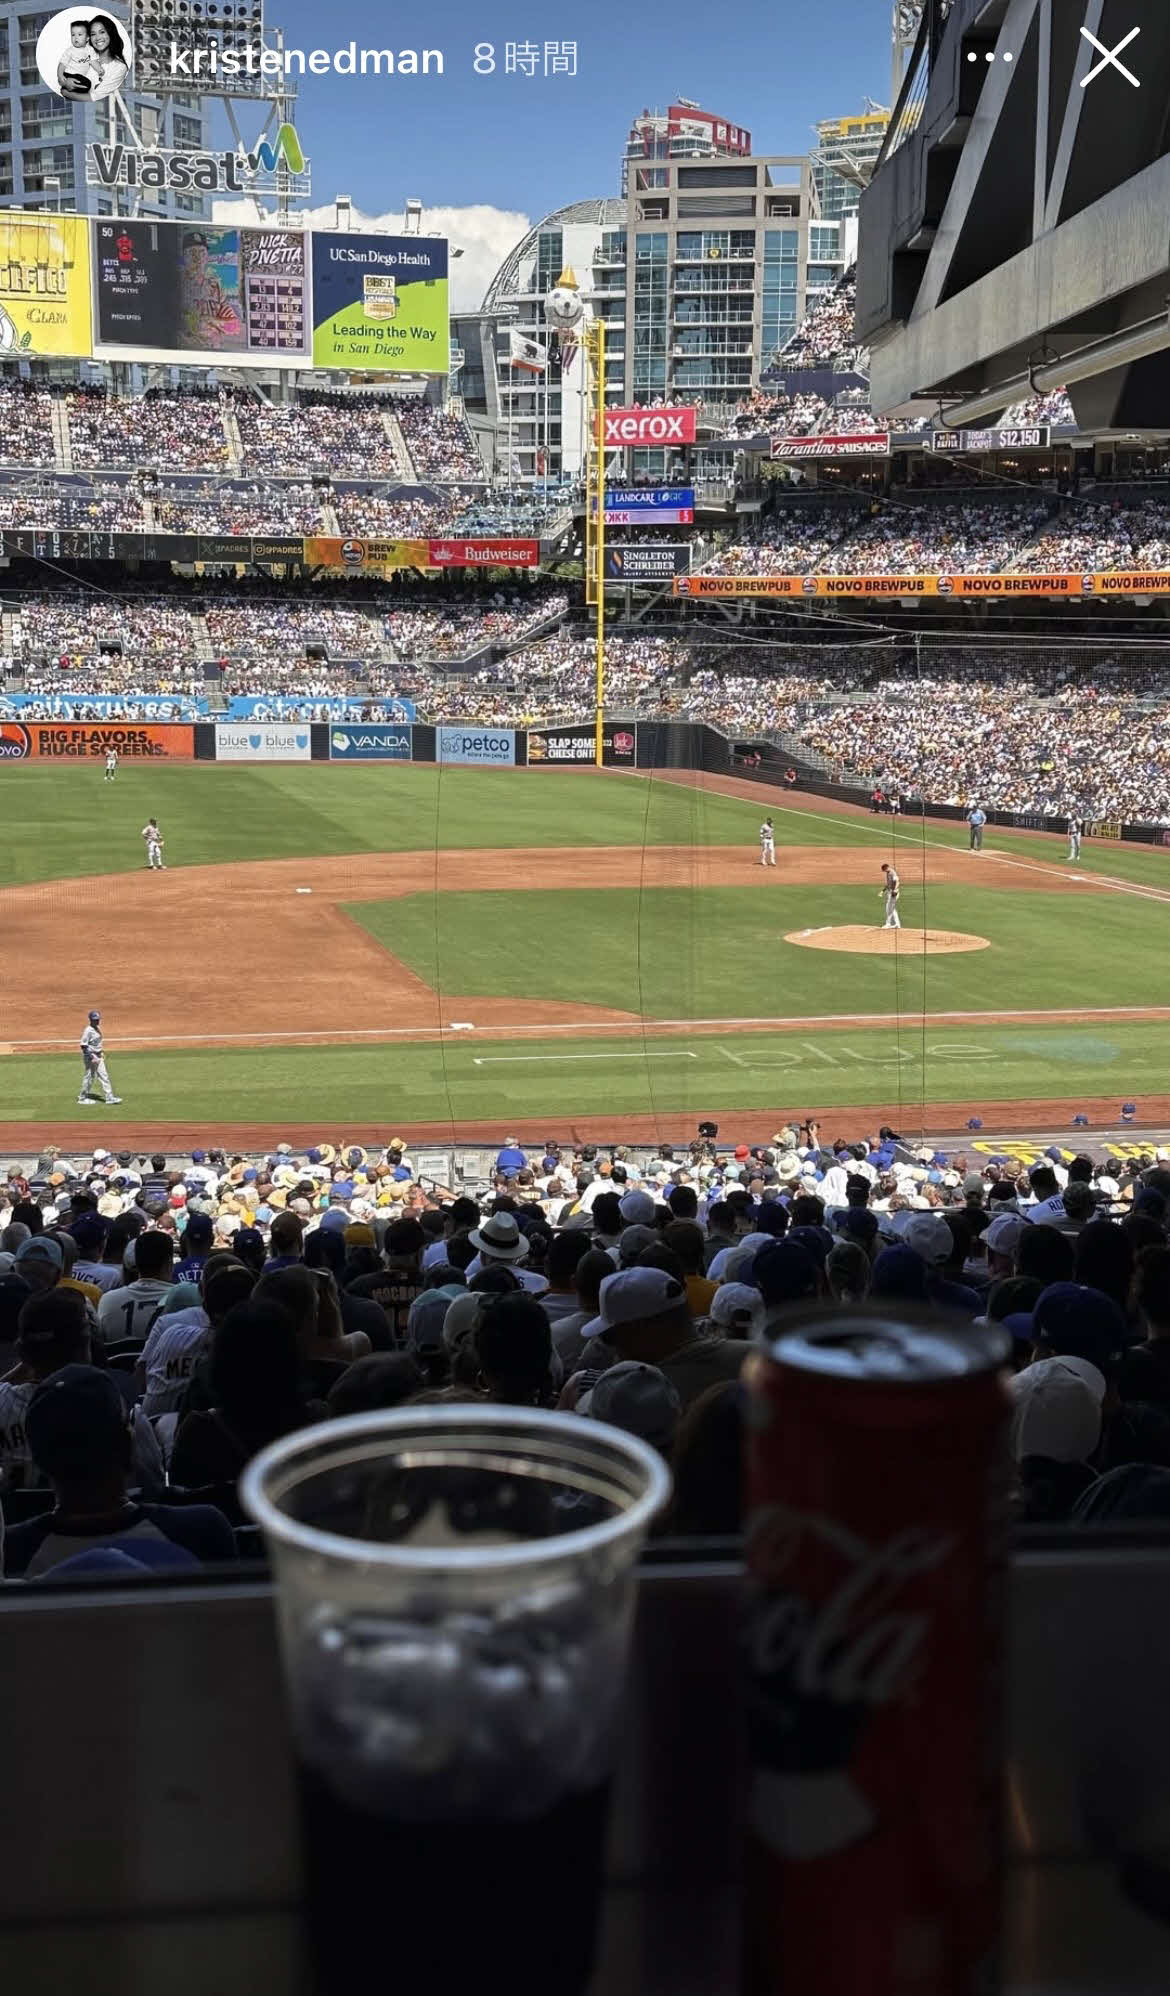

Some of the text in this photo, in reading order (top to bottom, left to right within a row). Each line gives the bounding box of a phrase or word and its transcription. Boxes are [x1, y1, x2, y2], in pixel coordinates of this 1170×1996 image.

[91, 143, 243, 192] Viasat
[102, 227, 113, 237] 50
[259, 234, 288, 249] NICK
[368, 250, 397, 266] Diego
[398, 252, 431, 266] Health
[333, 323, 437, 341] Leading the Way
[333, 342, 405, 357] in San Diego
[606, 416, 684, 440] xerox
[999, 429, 1040, 448] $12,150
[773, 440, 887, 456] Tarantino SAUSAGES
[615, 492, 656, 504] LANDCARE
[17, 537, 24, 549] F
[53, 532, 60, 543] 0
[53, 545, 60, 558] 5
[108, 547, 115, 559] 5
[367, 544, 396, 553] BREW
[465, 546, 533, 561] Budweiser
[623, 551, 675, 560] SINGLETON
[700, 580, 791, 591] NOVO BREWPUB
[827, 580, 924, 591] NOVO BREWPUB
[963, 579, 1068, 590] NOVO BREWPUB
[1102, 576, 1170, 588] NOVO BREWP
[39, 731, 68, 743] BIG
[219, 735, 248, 746] blue
[266, 735, 295, 746] blue
[351, 735, 409, 747] VANDA
[462, 735, 509, 752] petco
[548, 738, 597, 749] SLAP SOME
[40, 744, 86, 756] HUGE
[548, 749, 575, 758] CHEESE
[576, 749, 588, 758] ON
[714, 1042, 1000, 1067] blue
[120, 1300, 160, 1335] 17
